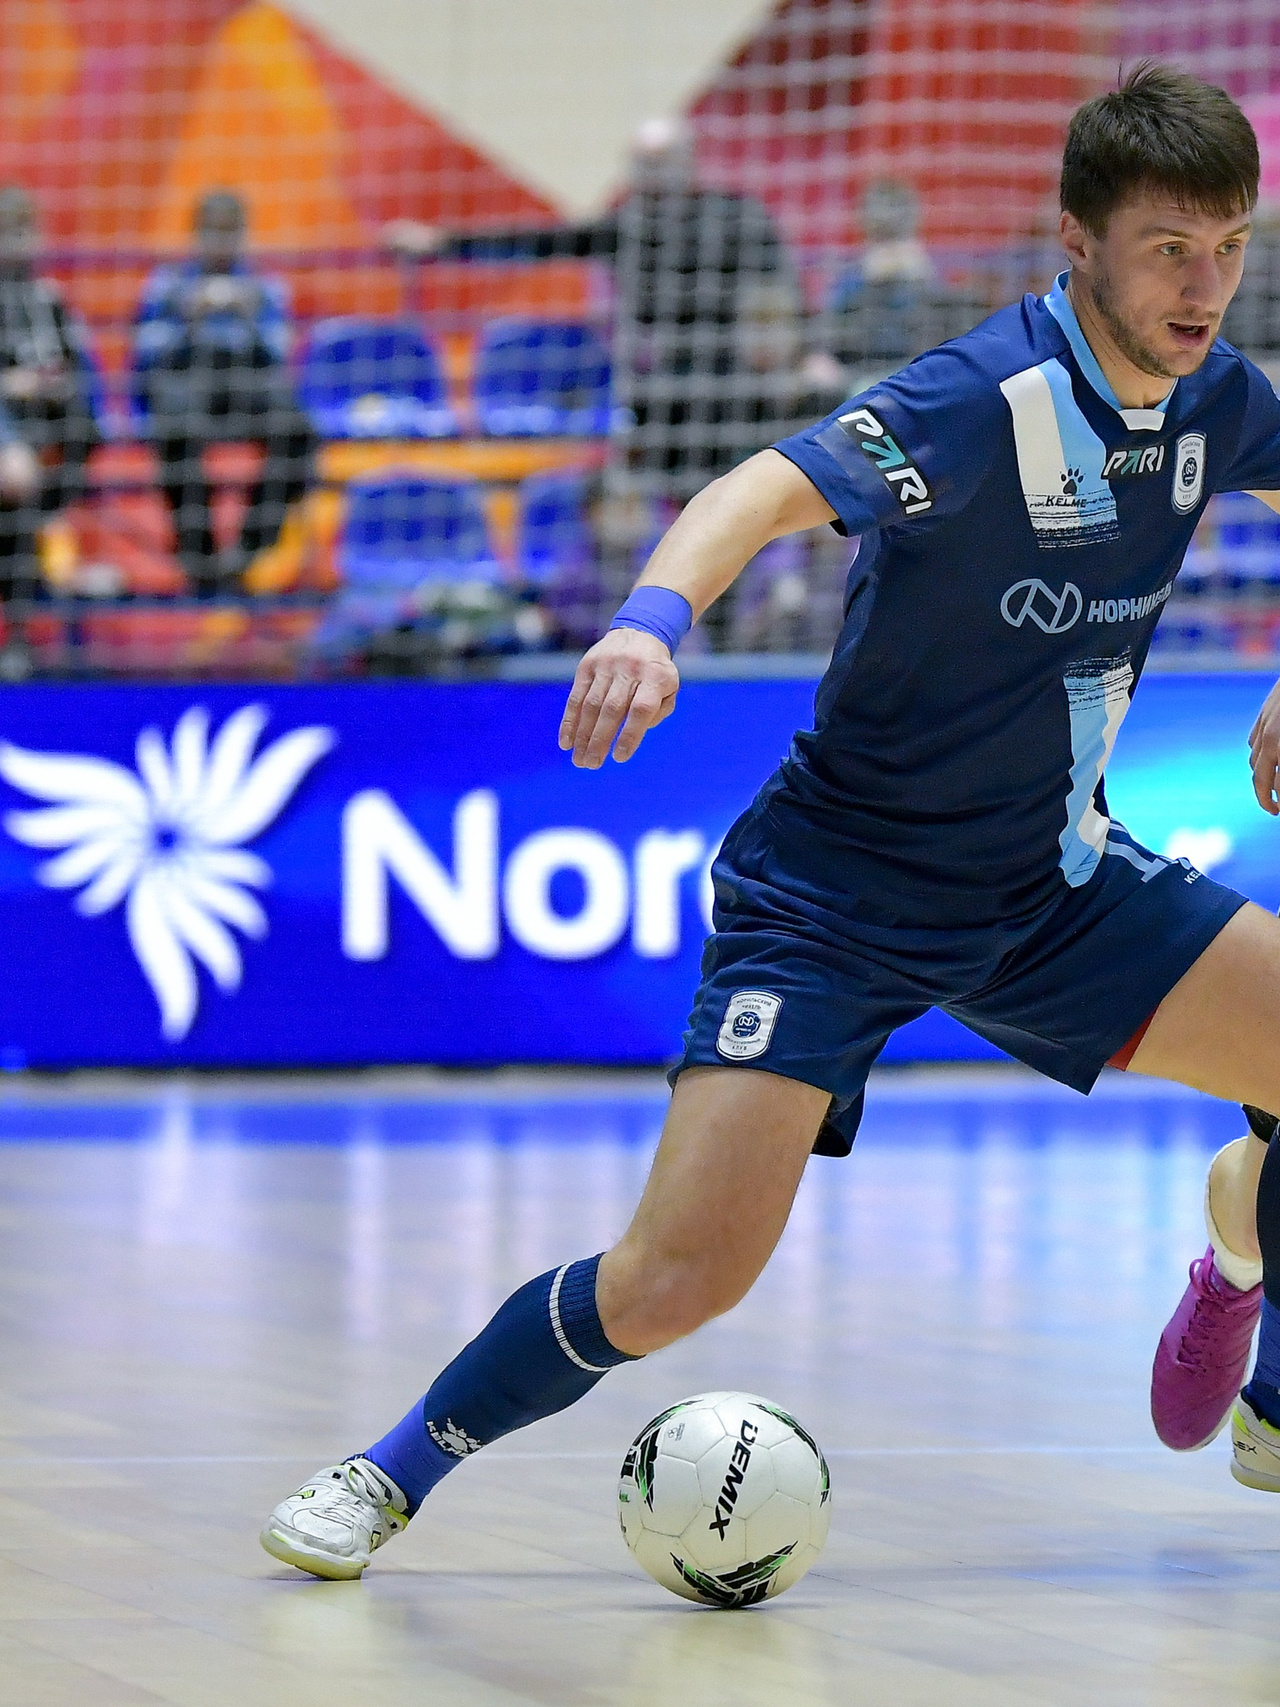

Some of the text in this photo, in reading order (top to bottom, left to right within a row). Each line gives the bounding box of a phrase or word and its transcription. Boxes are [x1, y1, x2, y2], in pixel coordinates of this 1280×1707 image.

[837, 408, 933, 515] PARI
[1044, 495, 1088, 508] KELME
[1102, 444, 1166, 476] PARI
[341, 787, 724, 963] Nor
[708, 1419, 760, 1542] DEMIX
